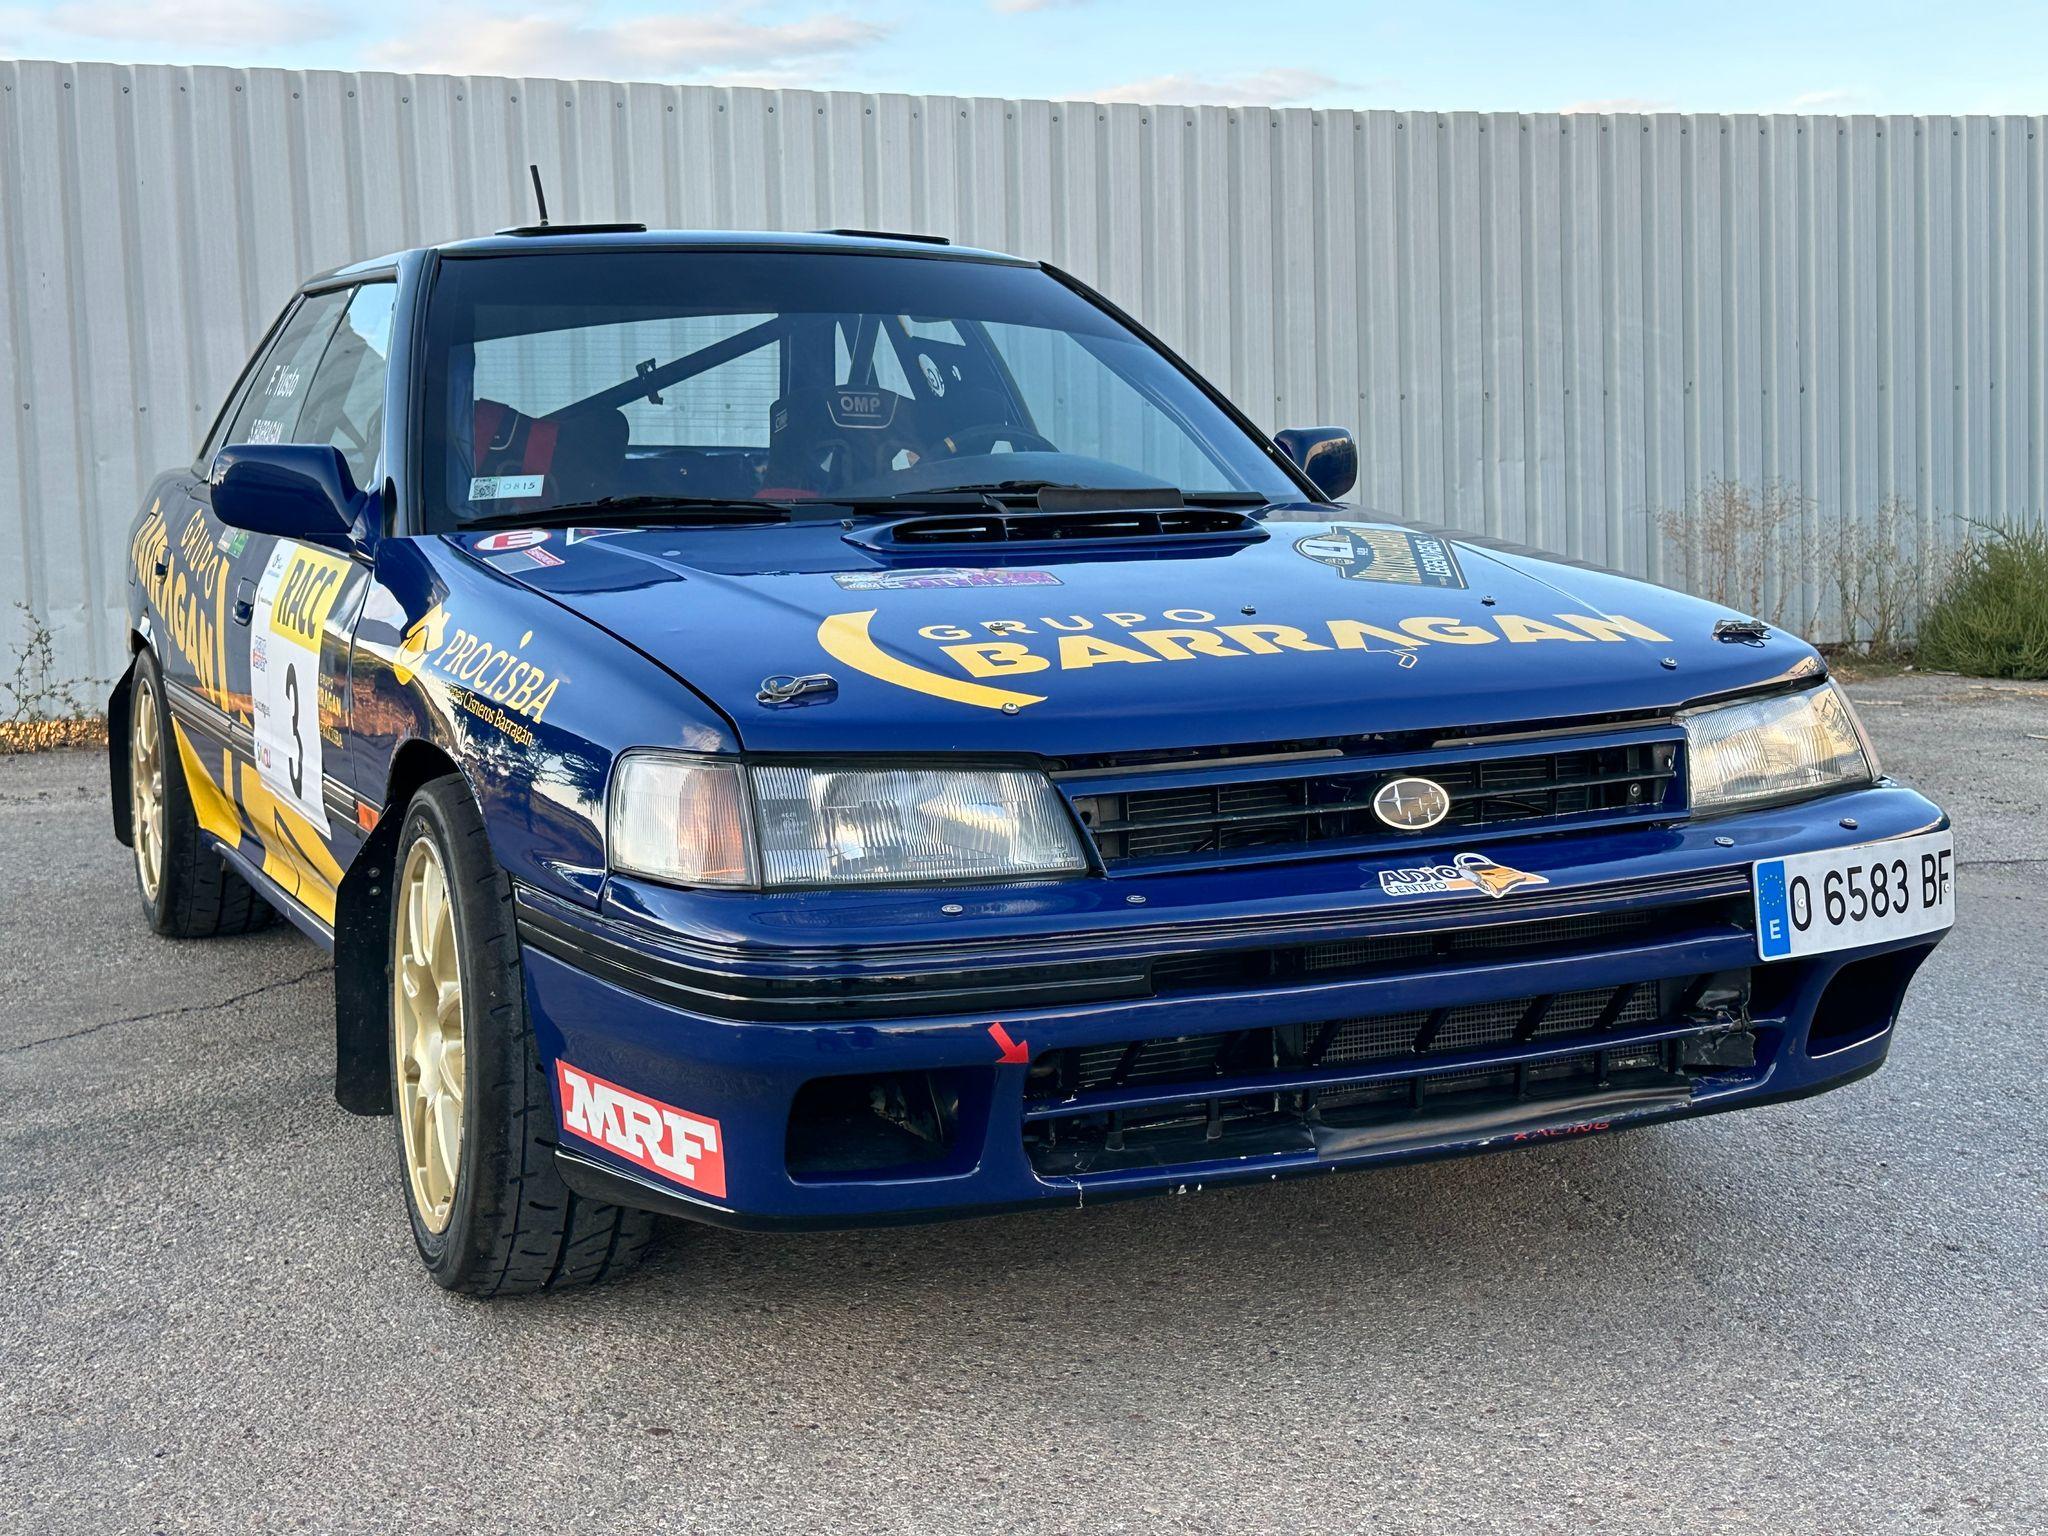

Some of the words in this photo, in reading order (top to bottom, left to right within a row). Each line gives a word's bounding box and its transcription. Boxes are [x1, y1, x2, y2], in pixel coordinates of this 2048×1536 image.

[840, 395, 881, 413] OMP
[181, 508, 218, 599] GRUPO
[277, 558, 338, 640] RACC
[918, 608, 1216, 641] GRUPO
[938, 615, 1674, 678] BARRAGAN
[285, 662, 304, 800] 3
[463, 691, 496, 724] Cisneros
[494, 708, 533, 747] Barragán
[1386, 881, 1447, 895] CENTRO
[1824, 859, 1910, 926] 6583
[1921, 849, 1951, 909] BF
[1769, 919, 1781, 940] E
[563, 1068, 718, 1181] MRF
